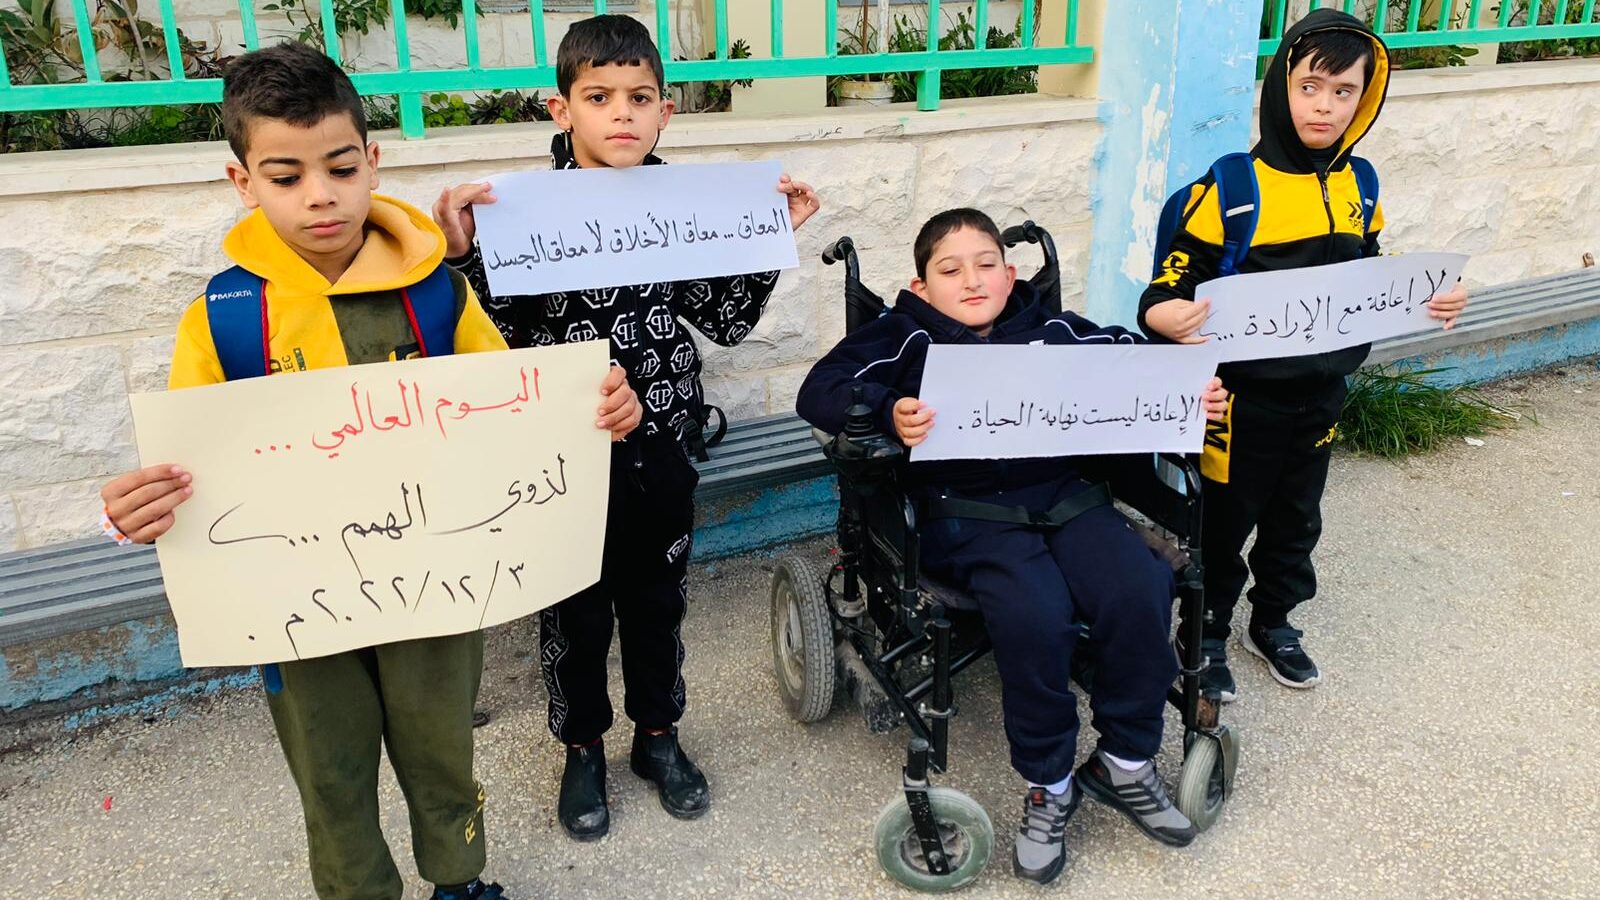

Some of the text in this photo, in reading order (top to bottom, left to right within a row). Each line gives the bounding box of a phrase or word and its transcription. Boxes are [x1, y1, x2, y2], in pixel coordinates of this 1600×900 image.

[584, 218, 603, 254] لا
[609, 211, 679, 253] الأخلاق
[682, 212, 719, 244] معاق
[737, 207, 788, 240] المعاق
[487, 233, 547, 271] الجسد
[547, 230, 588, 262] معاق
[1369, 276, 1415, 315] إعاقة
[1419, 268, 1448, 306] لا
[1244, 295, 1331, 344] الإرادة
[1337, 303, 1363, 335] مع
[311, 378, 425, 459] العالمي
[434, 366, 541, 440] اليوم
[1082, 395, 1140, 427] ليست
[432, 452, 568, 535] لذوي
[341, 481, 428, 580] الهمم
